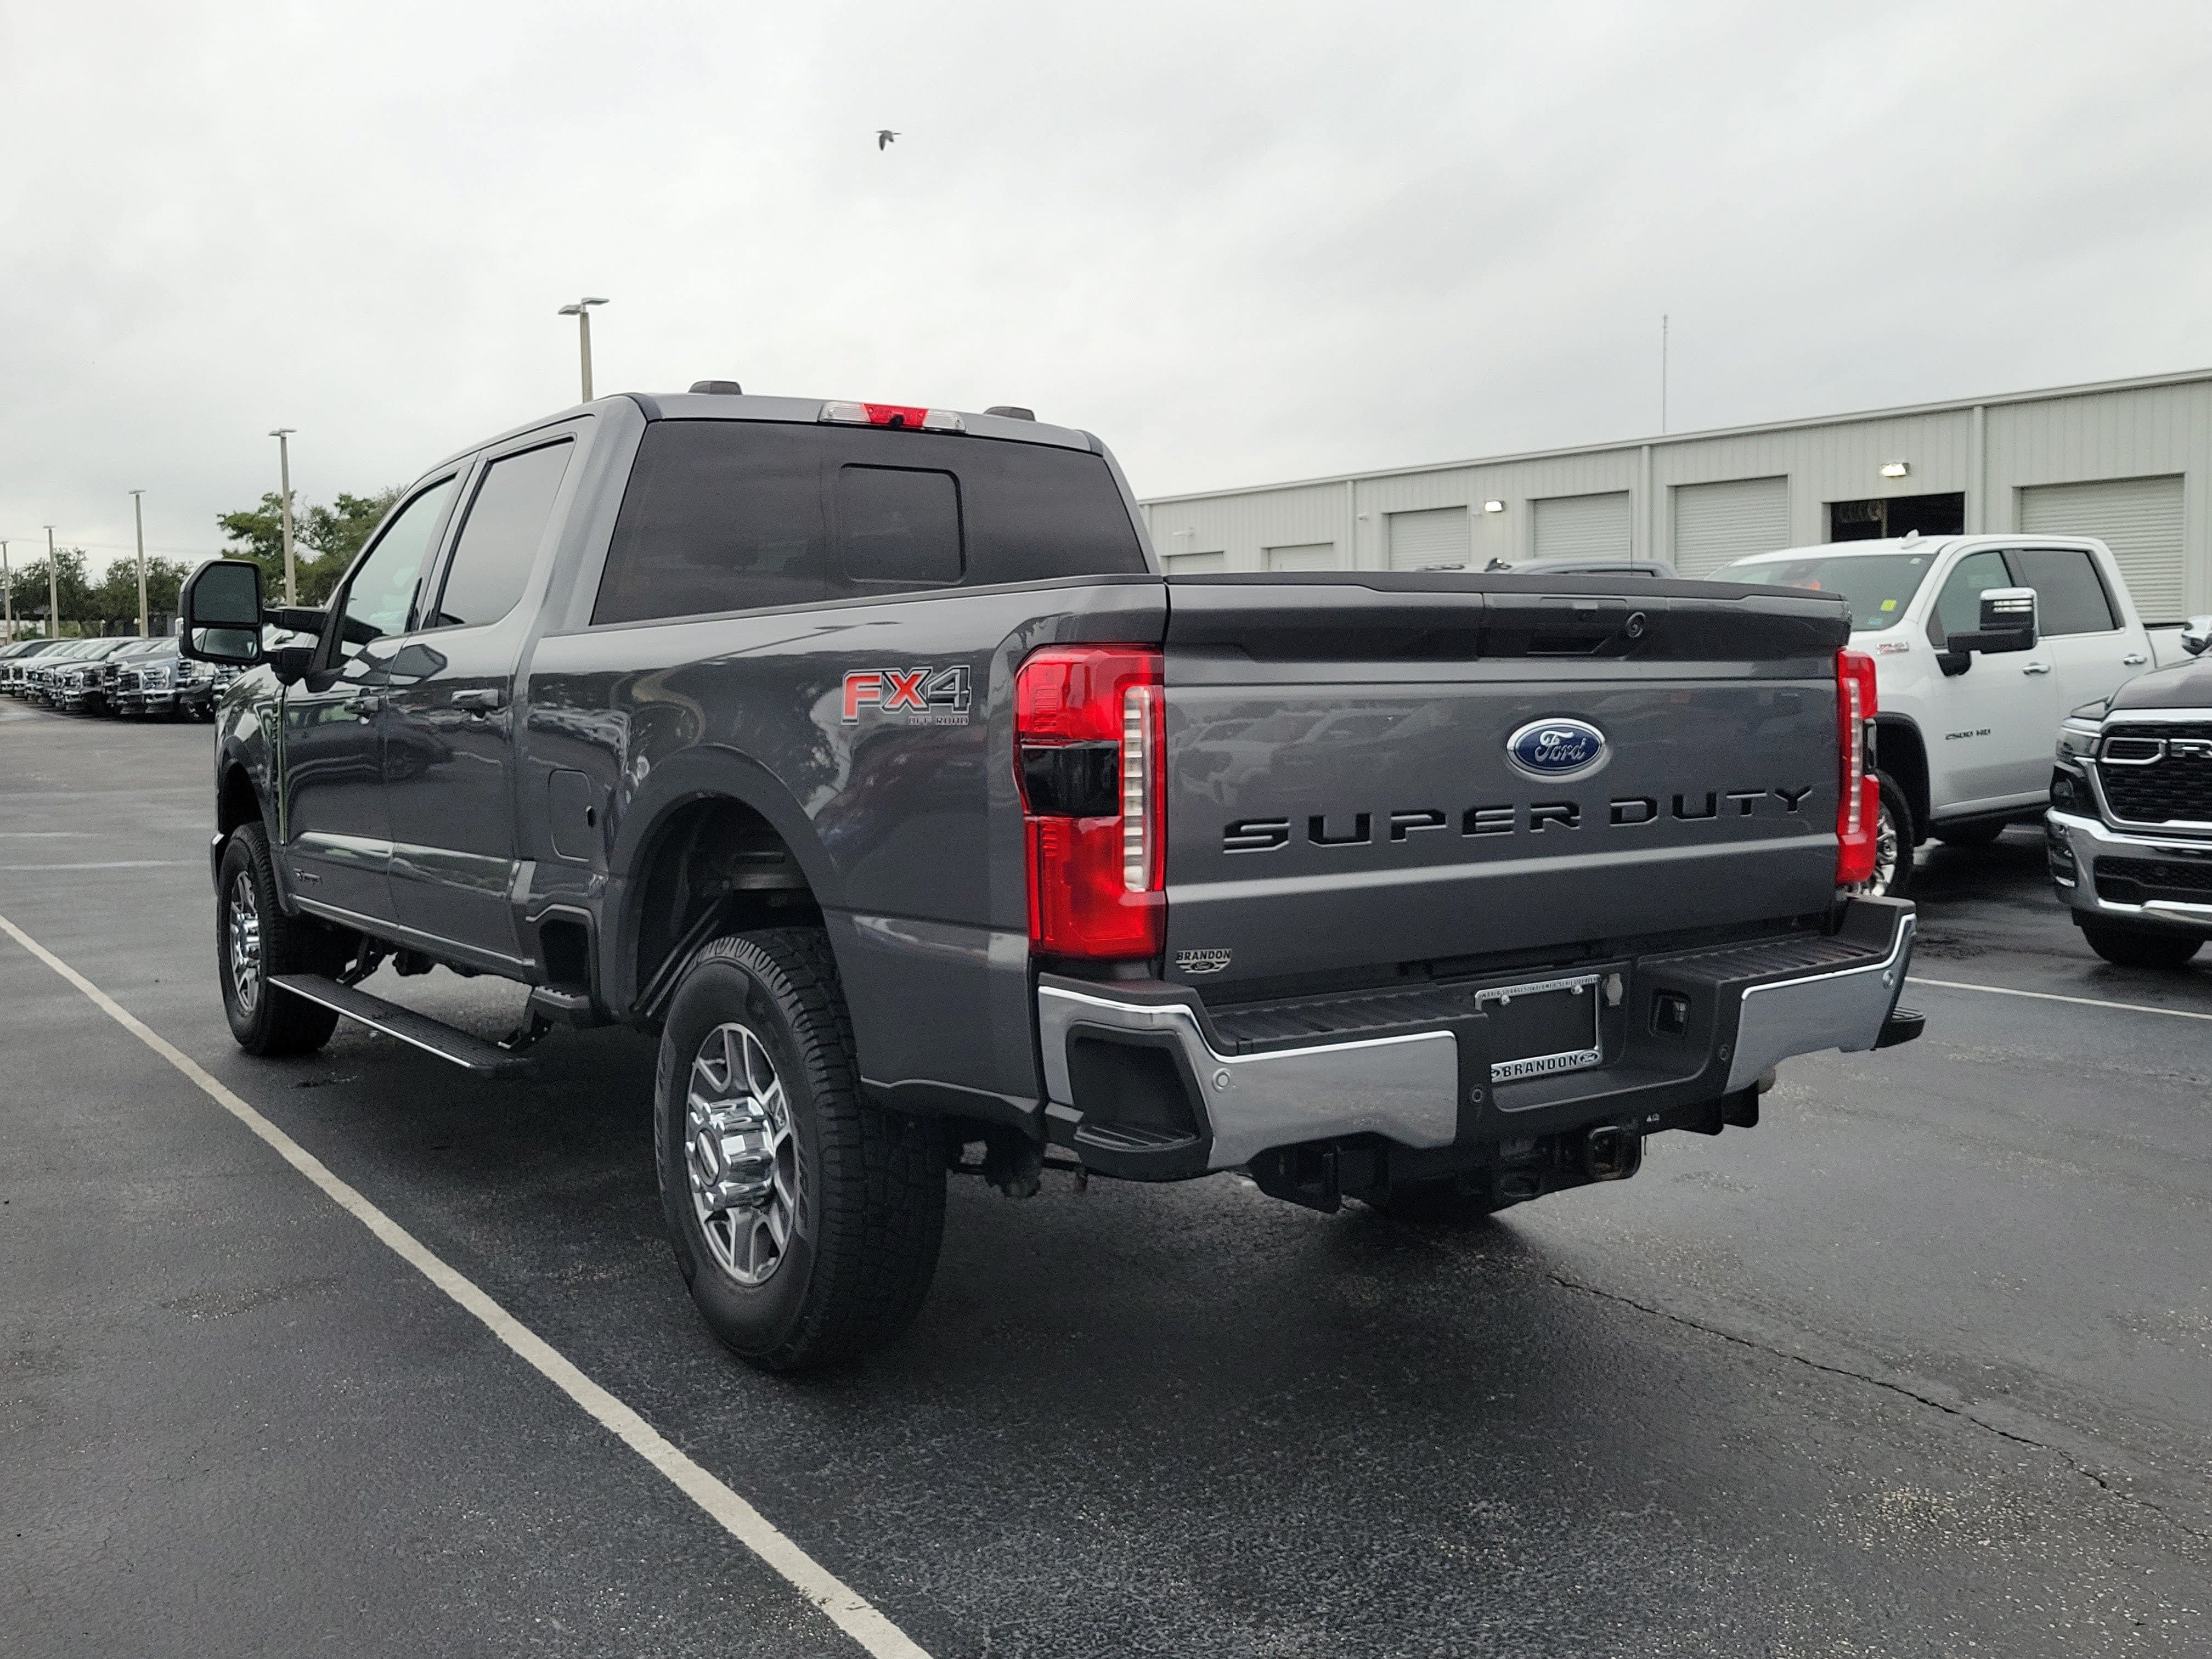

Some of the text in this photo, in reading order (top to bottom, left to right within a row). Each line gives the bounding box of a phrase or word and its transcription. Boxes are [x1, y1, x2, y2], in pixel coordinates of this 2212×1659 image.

[841, 665, 972, 725] FX4
[909, 715, 969, 725] OFF ROAD
[1534, 730, 1586, 762] Ford
[1223, 786, 1812, 854] SUPER DUTY
[1177, 950, 1231, 961] BRANDON
[1502, 1054, 1578, 1077] BRANDON
